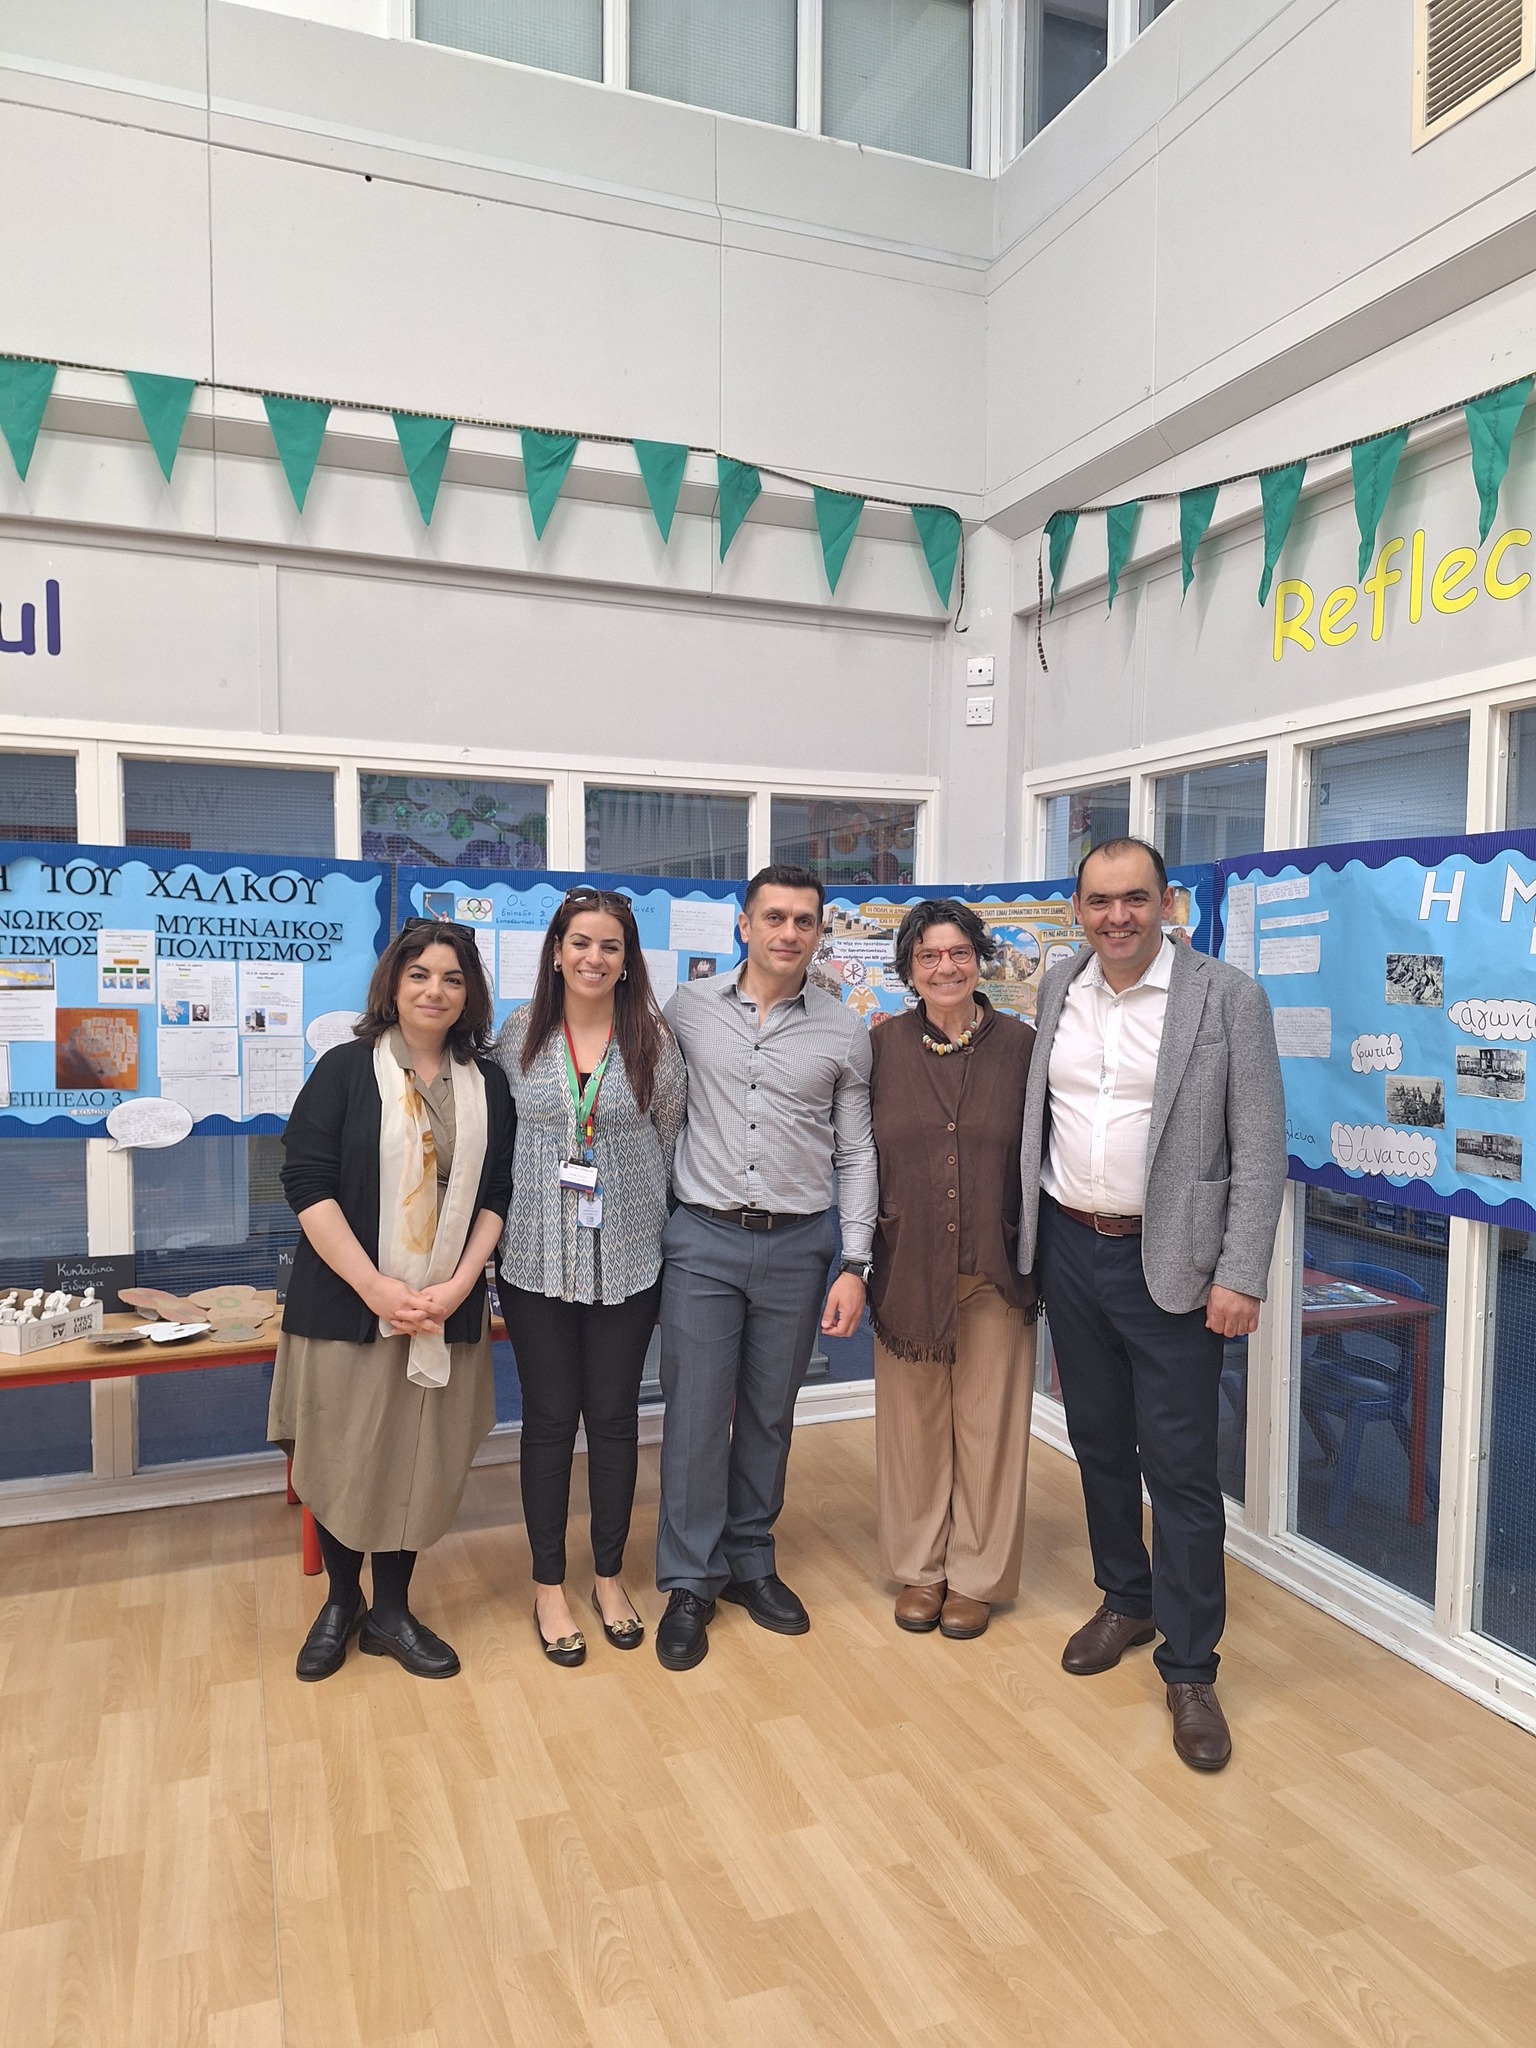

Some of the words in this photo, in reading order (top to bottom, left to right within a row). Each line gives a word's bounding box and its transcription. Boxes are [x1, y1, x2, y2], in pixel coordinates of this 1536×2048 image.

[41, 865, 122, 896] ΤΟΥ
[146, 869, 324, 905] ΧΑΛΚΟΥ
[1418, 870, 1466, 922] Η
[156, 914, 344, 941] ΜΥΚΗΝΑΙΚΟΣ
[156, 937, 332, 962] ΠΟΛΙΤΙΣΜΟΣ
[1461, 1007, 1536, 1031] αγωνί
[1355, 1042, 1396, 1062] φωτιά
[112, 1091, 122, 1107] 3
